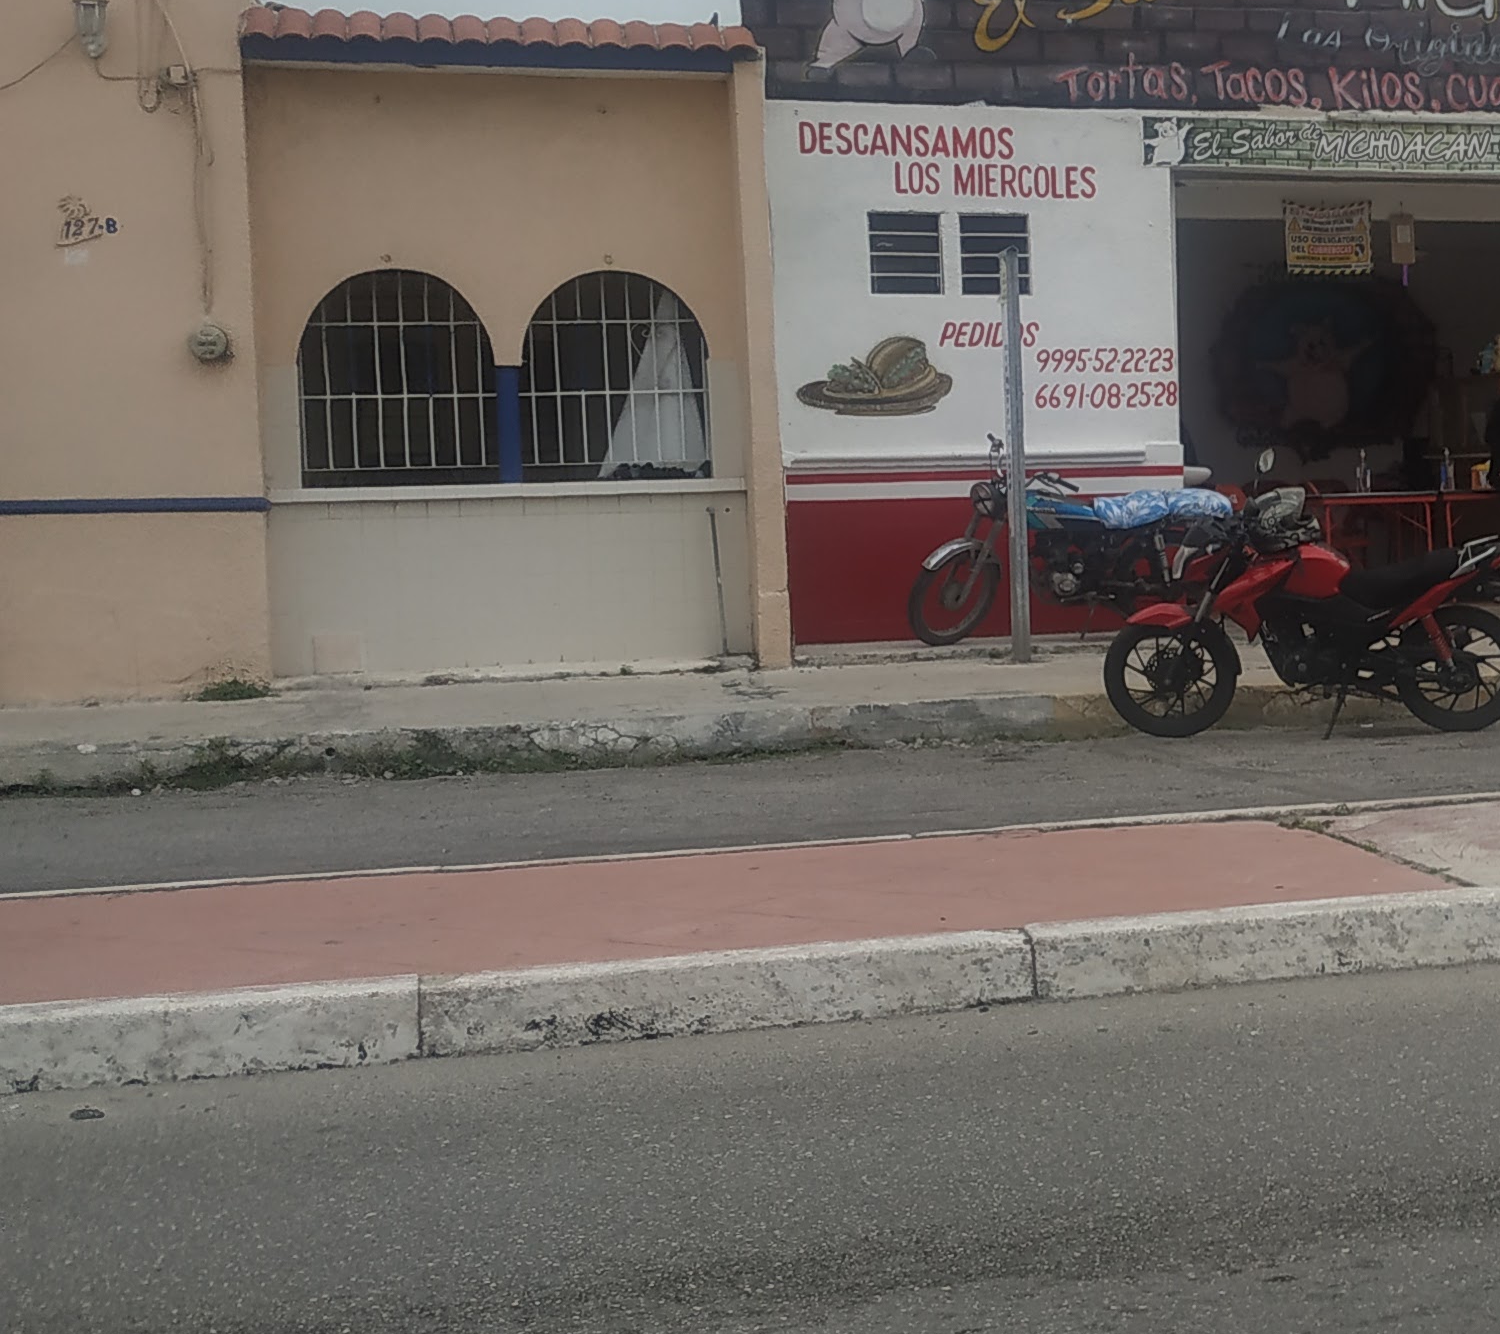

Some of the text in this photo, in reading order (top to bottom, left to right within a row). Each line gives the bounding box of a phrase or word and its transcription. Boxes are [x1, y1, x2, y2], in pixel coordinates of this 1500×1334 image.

[799, 121, 1015, 160] DESCANSAMOS
[1193, 132, 1222, 161] El
[1230, 123, 1298, 155] Sabor
[1302, 122, 1322, 141] de
[1314, 129, 1492, 163] MICHOACAN
[894, 162, 1097, 199] LOS MIERCOLES
[1291, 235, 1364, 244] USO OBLIGATORIO
[1291, 245, 1306, 253] DEL
